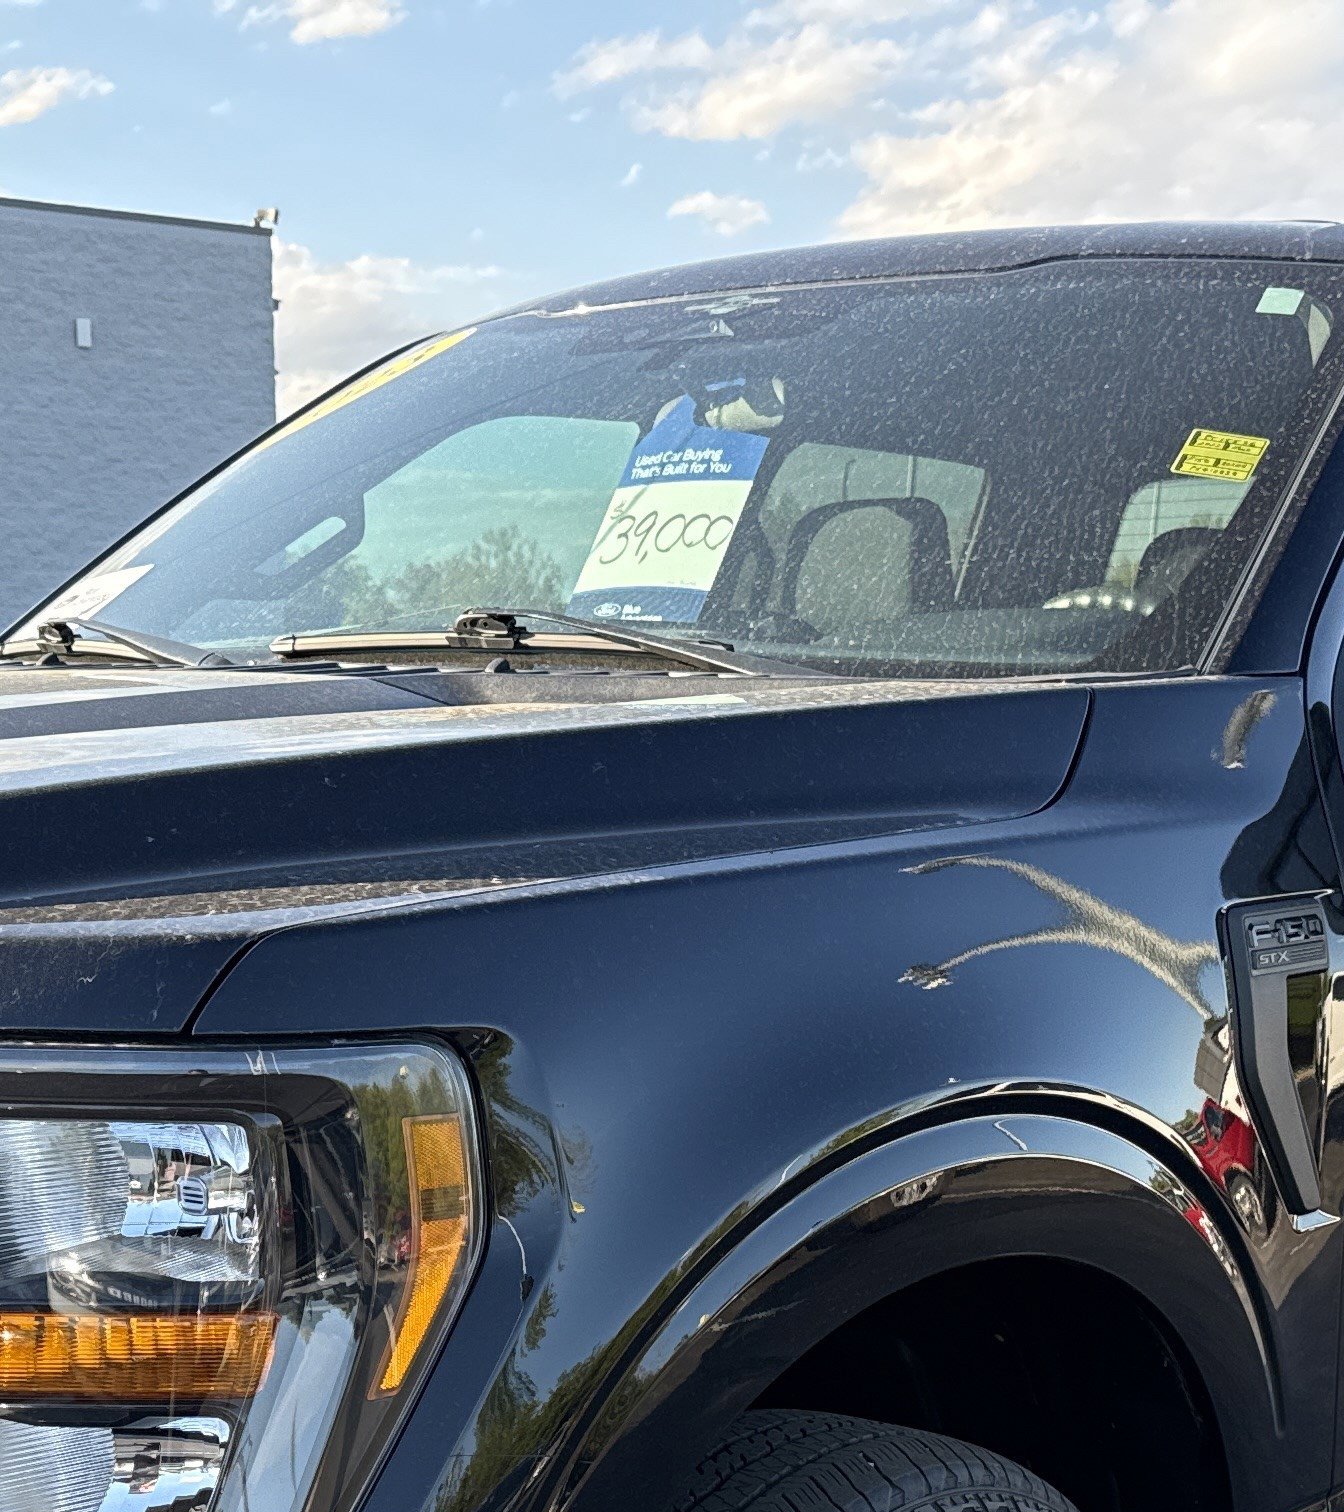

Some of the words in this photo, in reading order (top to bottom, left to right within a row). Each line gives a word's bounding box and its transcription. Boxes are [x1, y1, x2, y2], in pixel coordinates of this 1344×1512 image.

[635, 452, 663, 467] Used
[663, 450, 683, 462] Car
[682, 448, 723, 462] Buying
[631, 465, 661, 479] That's
[662, 462, 689, 475] Built
[690, 462, 707, 473] for
[709, 461, 733, 474] You
[1247, 914, 1325, 948] F-150
[1259, 950, 1290, 965] STX
